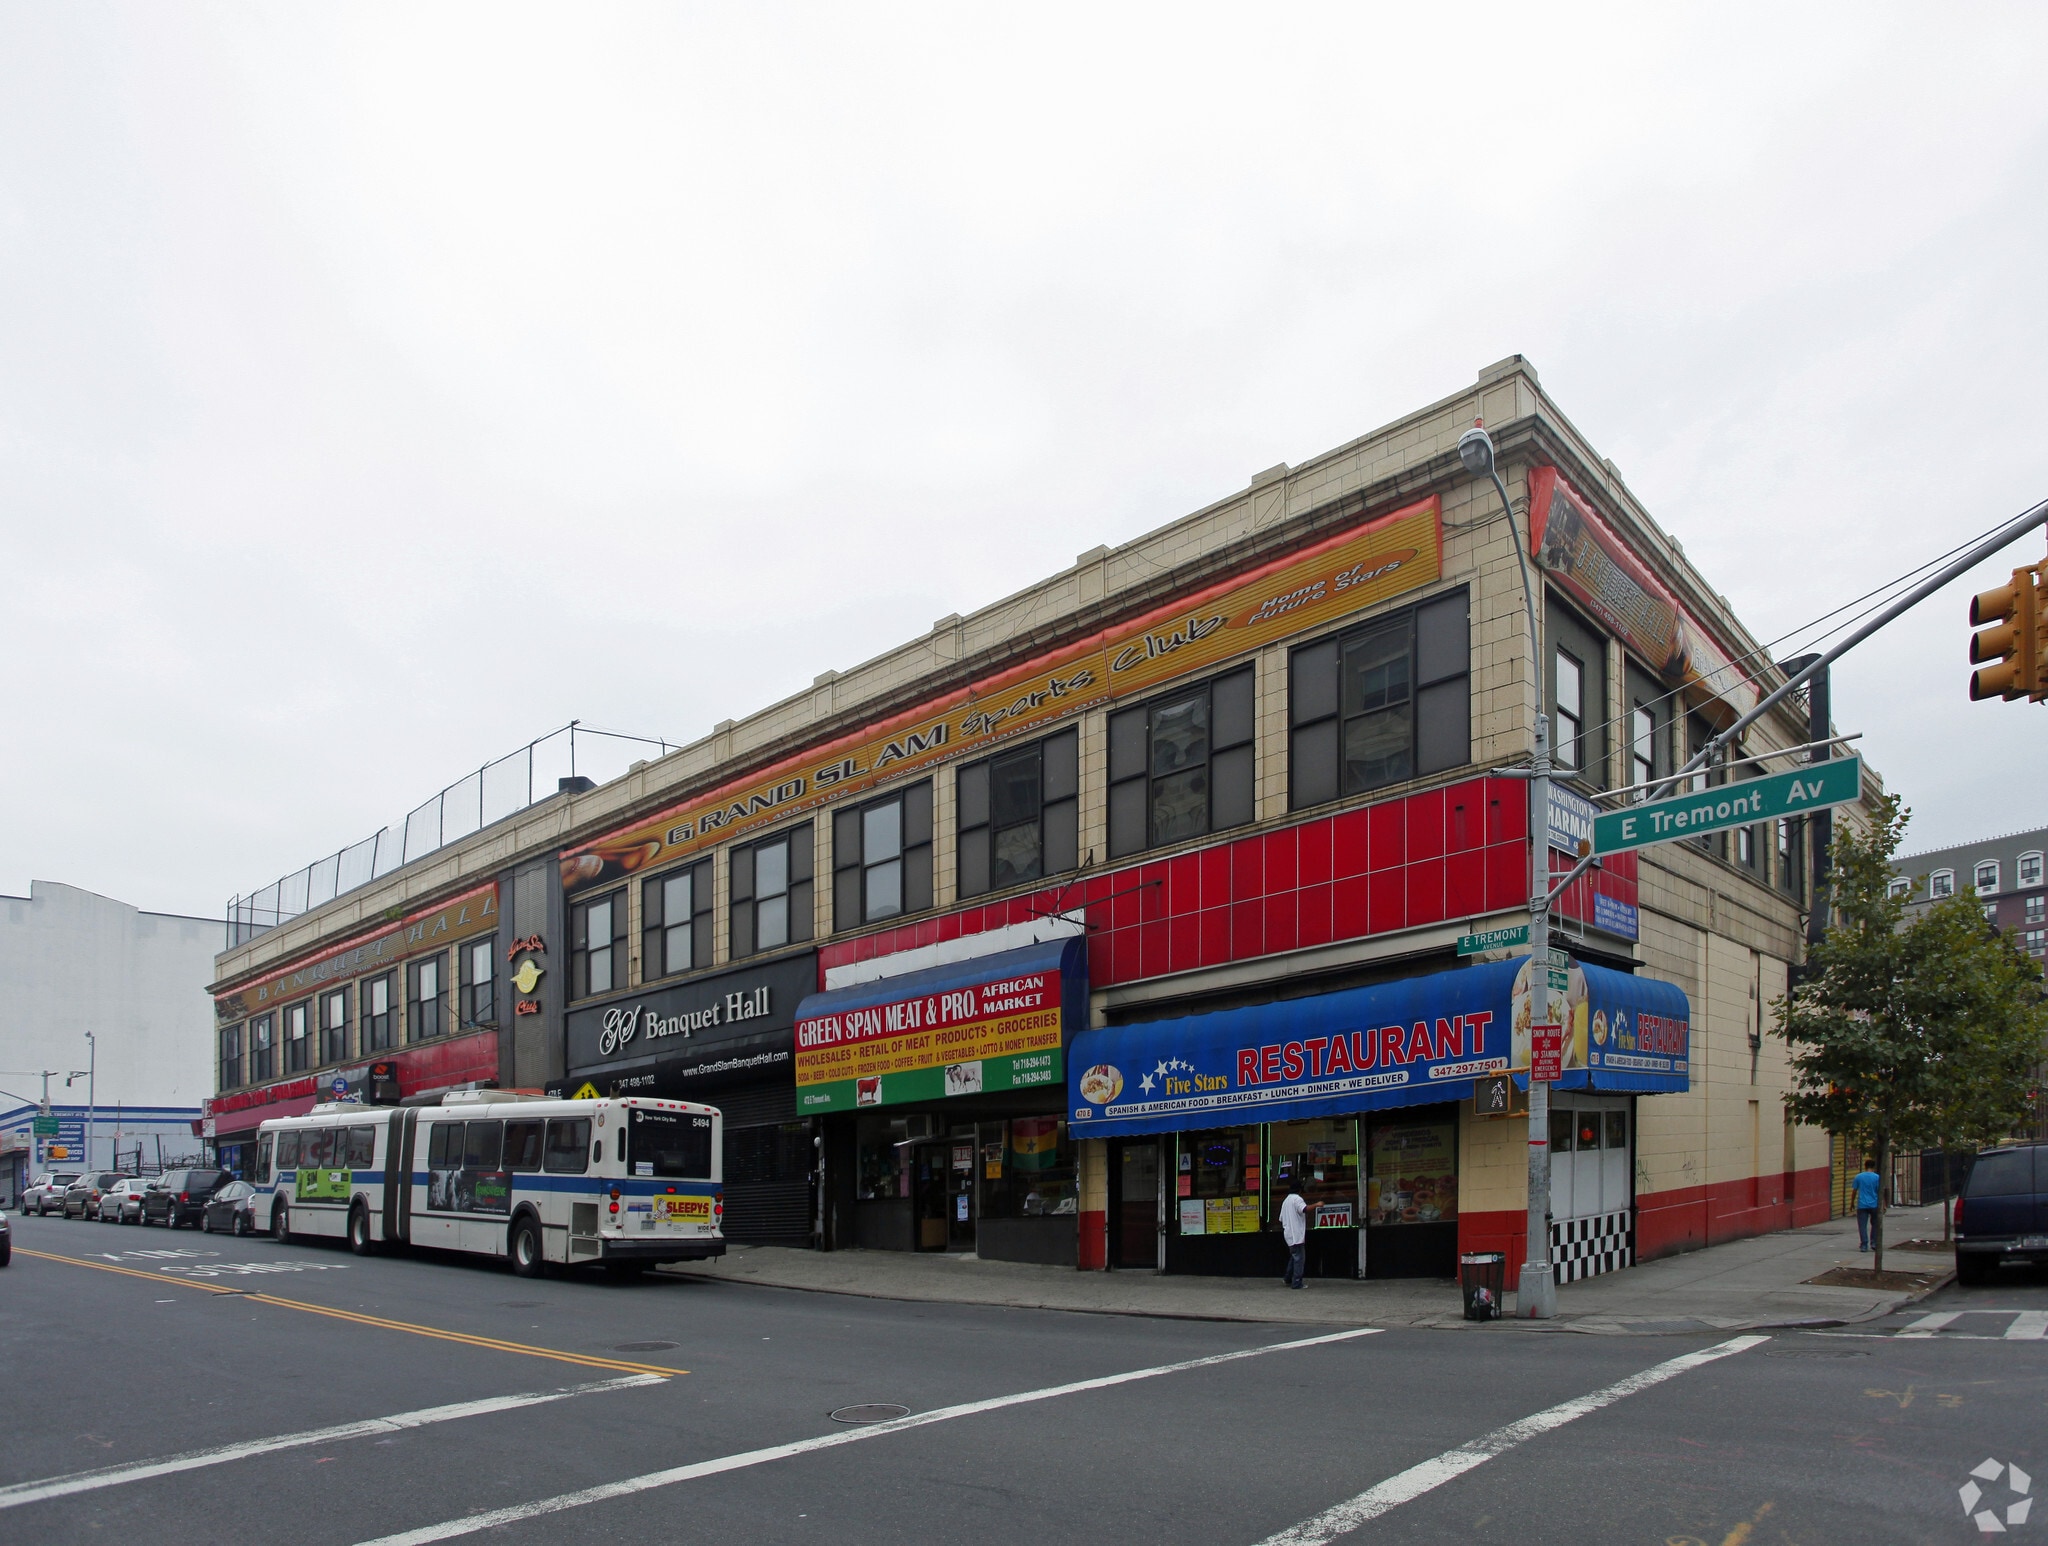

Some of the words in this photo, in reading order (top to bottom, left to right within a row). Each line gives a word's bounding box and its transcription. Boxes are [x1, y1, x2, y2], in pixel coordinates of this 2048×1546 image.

[1247, 589, 1327, 626] Future
[1333, 560, 1402, 592] Stars
[1260, 579, 1327, 611] Home
[1334, 562, 1364, 582] of
[665, 777, 805, 847] GRAND
[814, 721, 949, 789] SLAM
[1112, 615, 1223, 673] Club
[772, 788, 850, 821] 498-1102
[1621, 816, 1638, 841] E
[1650, 789, 1763, 834] Tremont
[1785, 777, 1825, 805] Av
[257, 935, 390, 1001] BANQUET
[409, 897, 497, 945] HALL
[1464, 936, 1470, 947] E
[1474, 927, 1523, 945] TREMONT
[1483, 941, 1504, 951] AVENUE
[981, 975, 1044, 998] AFRICAN
[645, 1001, 721, 1040] Banquet
[726, 985, 771, 1023] Hall
[983, 993, 1043, 1014] MARKET
[798, 1015, 842, 1047] GREEN
[845, 1007, 881, 1040] SPAN
[885, 999, 923, 1033] MEAT
[925, 997, 937, 1026] &
[941, 989, 979, 1023] PRO.
[797, 1048, 851, 1068] WHOLESALES
[859, 1042, 889, 1058] RETAIL
[891, 1040, 903, 1054] OF
[905, 1035, 930, 1050] MEAT
[935, 1024, 987, 1046] PRODUCTS
[997, 1012, 1058, 1035] GROCERIES
[1533, 1029, 1545, 1038] SNOW
[1547, 1028, 1561, 1037] ROUTE
[1637, 1012, 1688, 1056] RESTAURANT
[813, 1070, 825, 1080] BEER
[828, 1068, 841, 1078] COLD
[858, 1062, 877, 1075] FROZEN
[877, 1060, 890, 1072] FOOD
[894, 1056, 914, 1069] COFFEE
[917, 1053, 933, 1065] FRUIT
[941, 1046, 975, 1061] VEGETABLES
[980, 1042, 997, 1055] LOTTO
[1005, 1038, 1025, 1051] MONEY
[1026, 1033, 1058, 1048] TRANSFER
[1236, 1010, 1494, 1088] RESTAURANT
[1533, 1051, 1539, 1059] NO
[1541, 1050, 1560, 1058] STANDING
[682, 1050, 789, 1078] www.GrandSlamBanquetHall.com
[1433, 1058, 1504, 1077] 347-297-7501
[1013, 1075, 1021, 1085] Fax
[1108, 1104, 1139, 1115] SPANISH
[1141, 1103, 1146, 1112] &
[1148, 1100, 1187, 1112] AMERICAN
[1188, 1098, 1209, 1108] FOOD
[1216, 1091, 1263, 1104] BREAKFAST
[1270, 1087, 1299, 1099] LUNCH
[1307, 1082, 1340, 1093] DINNER
[1348, 1077, 1362, 1088] WE
[1364, 1073, 1404, 1086] DELIVER
[1165, 1075, 1191, 1096] Five
[1194, 1073, 1228, 1093] Stars
[692, 1118, 710, 1128] 5494
[1076, 1109, 1086, 1118] 470
[1181, 1155, 1190, 1166] A
[1319, 1213, 1348, 1227] ATM
